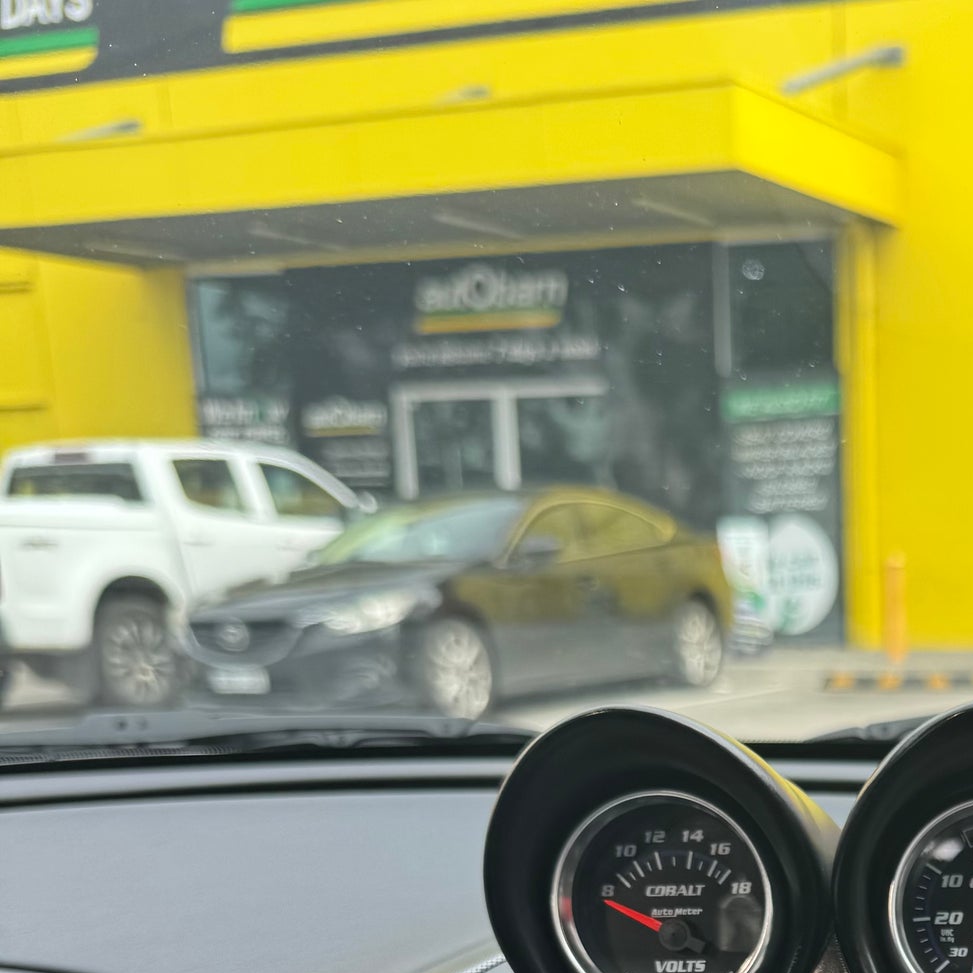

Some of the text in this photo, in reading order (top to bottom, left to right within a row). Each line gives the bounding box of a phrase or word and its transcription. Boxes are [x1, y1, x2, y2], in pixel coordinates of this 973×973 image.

[644, 830, 666, 843] 12
[682, 829, 704, 843] 14
[615, 844, 637, 858] 10
[709, 842, 731, 856] 16
[941, 874, 964, 888] 10
[601, 884, 615, 897] 8
[645, 884, 705, 897] COBALT
[731, 881, 752, 895] 18
[650, 907, 703, 917] Auto Meter
[934, 911, 964, 925] 20
[948, 947, 968, 957] 30
[655, 960, 706, 973] VOLTS
